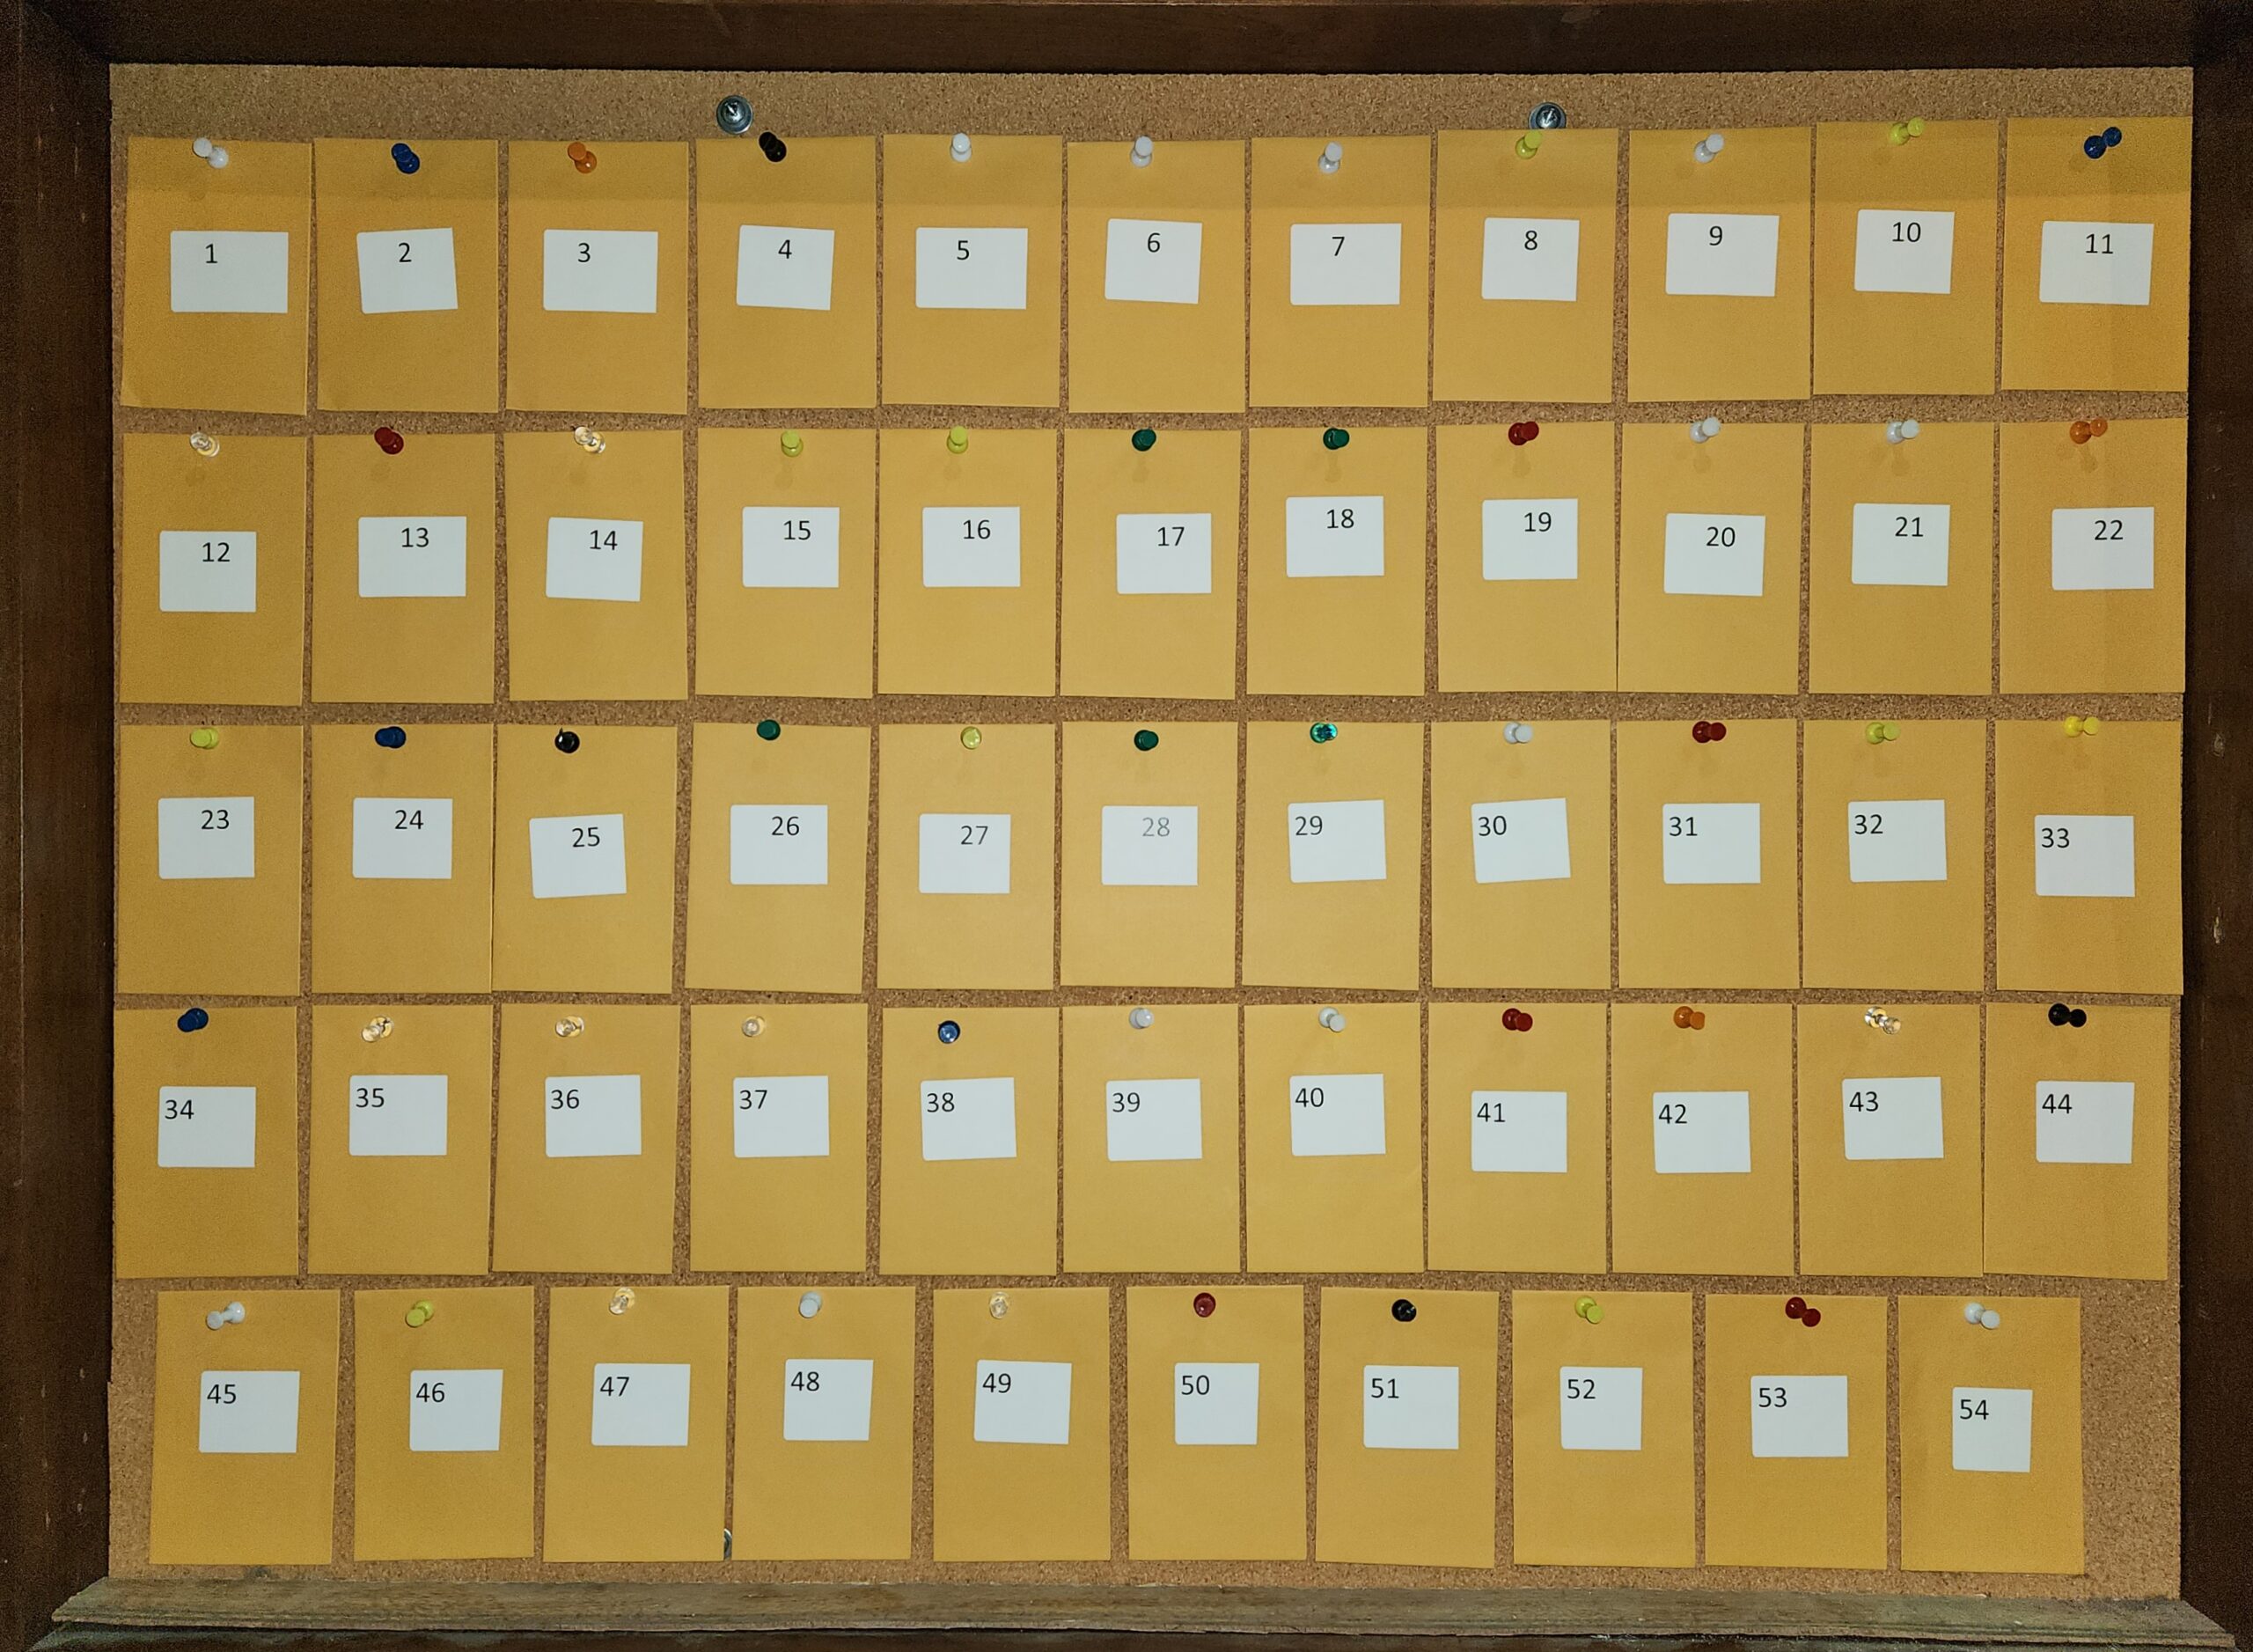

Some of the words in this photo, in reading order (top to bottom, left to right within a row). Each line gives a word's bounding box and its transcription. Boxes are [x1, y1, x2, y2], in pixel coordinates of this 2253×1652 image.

[1147, 231, 1161, 253] 6
[1523, 230, 1538, 252] 8
[1708, 224, 1723, 246] 9
[1891, 221, 1922, 243] 10
[204, 242, 219, 265] 1
[398, 241, 413, 263] 2
[577, 241, 591, 263] 3
[777, 239, 793, 260] 4
[956, 239, 970, 261] 5
[1332, 235, 1346, 257] 7
[2085, 232, 2114, 255] 11
[783, 519, 811, 541] 15
[963, 518, 991, 540] 16
[1326, 508, 1355, 530] 18
[1523, 511, 1552, 532] 19
[1894, 516, 1925, 538] 21
[2094, 518, 2125, 541] 22
[400, 526, 429, 548] 13
[589, 529, 619, 551] 14
[1157, 525, 1185, 547] 17
[1706, 525, 1736, 548] 20
[202, 541, 231, 563] 12
[201, 809, 230, 831] 23
[394, 809, 425, 831] 24
[771, 815, 800, 836] 26
[1141, 816, 1171, 838] 28
[1295, 815, 1323, 836] 29
[1478, 815, 1508, 837] 30
[1669, 816, 1699, 837] 31
[1853, 813, 1884, 835] 32
[571, 826, 601, 848] 25
[960, 825, 989, 846] 27
[2041, 826, 2070, 849] 33
[355, 1087, 385, 1109] 35
[550, 1089, 580, 1111] 36
[739, 1089, 768, 1111] 37
[927, 1091, 956, 1113] 38
[1112, 1091, 1141, 1113] 39
[1295, 1087, 1325, 1108] 40
[1848, 1090, 1879, 1112] 43
[2041, 1092, 2073, 1115] 44
[164, 1098, 195, 1120] 34
[1476, 1102, 1507, 1123] 41
[1658, 1104, 1688, 1125] 42
[599, 1376, 630, 1398] 47
[790, 1370, 820, 1392] 48
[981, 1372, 1012, 1394] 49
[1180, 1374, 1210, 1396] 50
[1370, 1377, 1400, 1399] 51
[1567, 1378, 1596, 1400] 52
[206, 1383, 237, 1405] 45
[415, 1382, 445, 1404] 46
[1758, 1386, 1787, 1408] 53
[1959, 1399, 1990, 1421] 54
